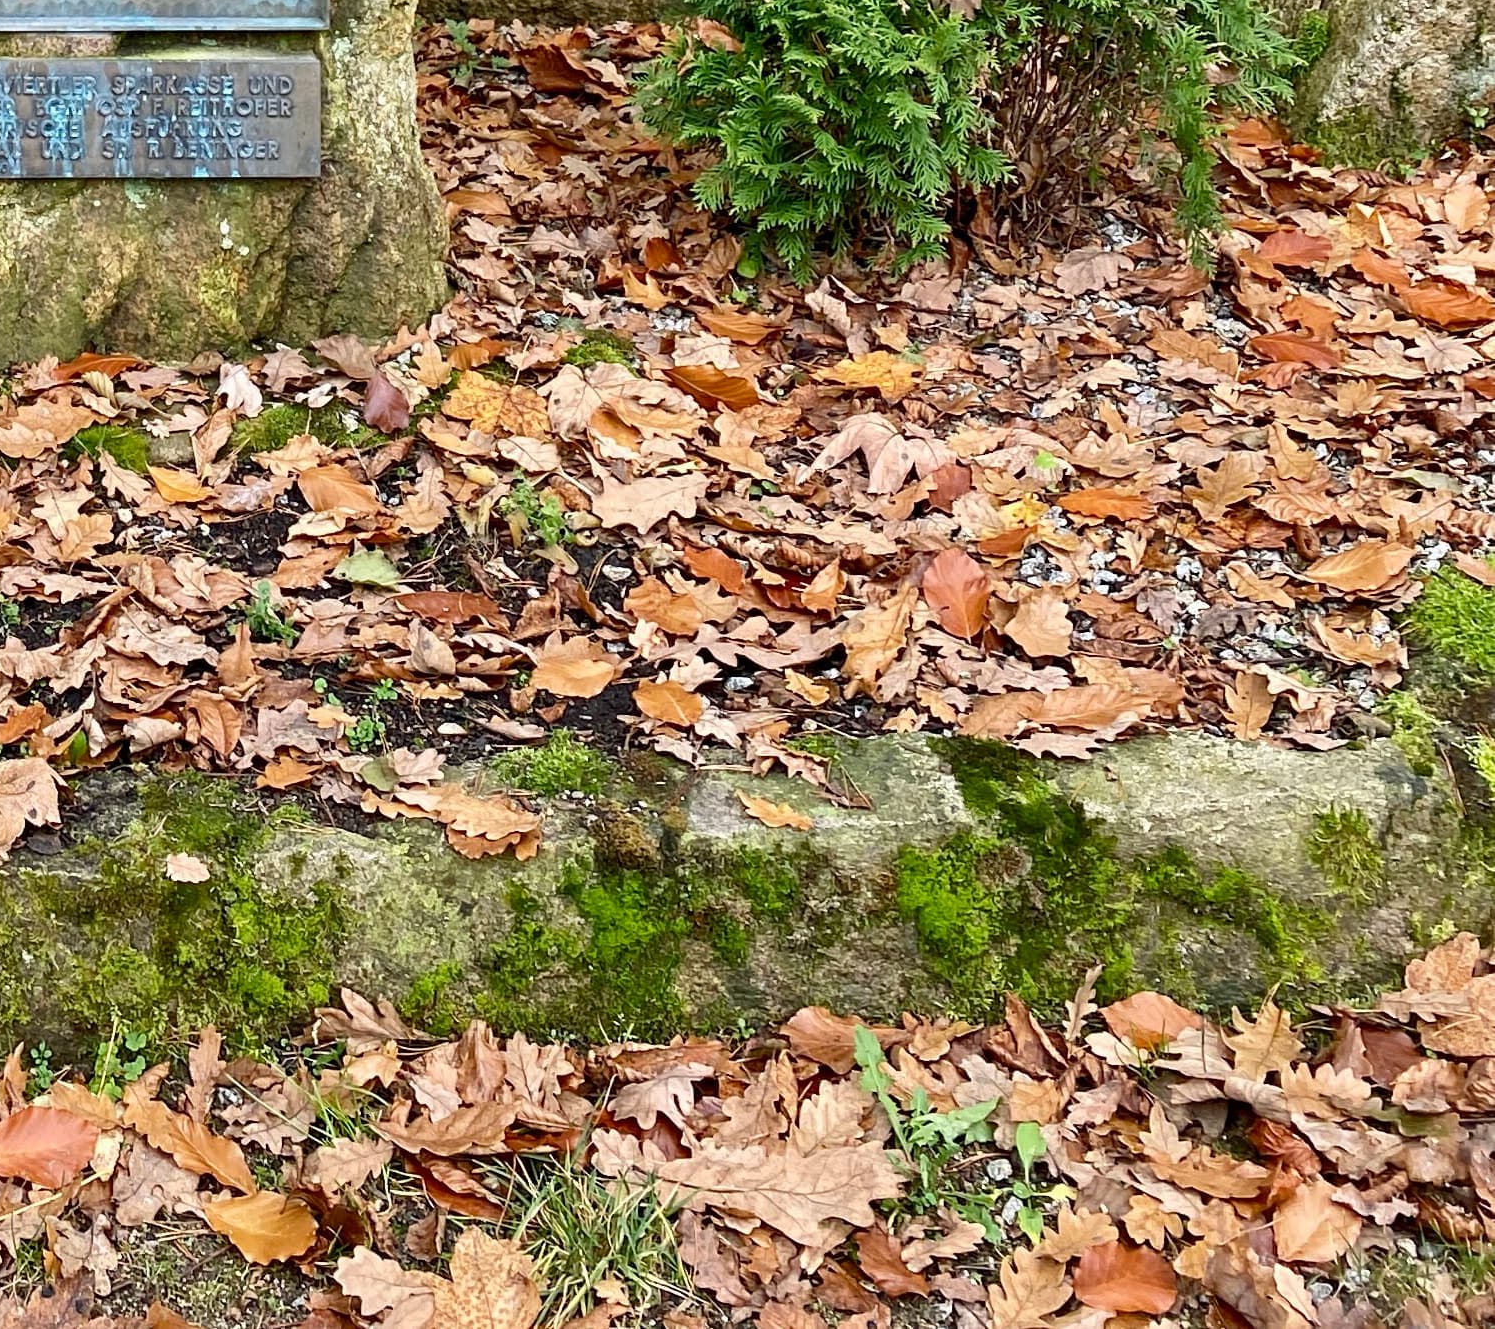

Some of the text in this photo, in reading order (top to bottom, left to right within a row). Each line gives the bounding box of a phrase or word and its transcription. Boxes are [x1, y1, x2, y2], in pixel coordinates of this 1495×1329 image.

[111, 75, 235, 95] SPARKASSE
[249, 75, 294, 95] UND
[176, 96, 293, 117] REITHOFER
[172, 139, 281, 160] BENINGER
